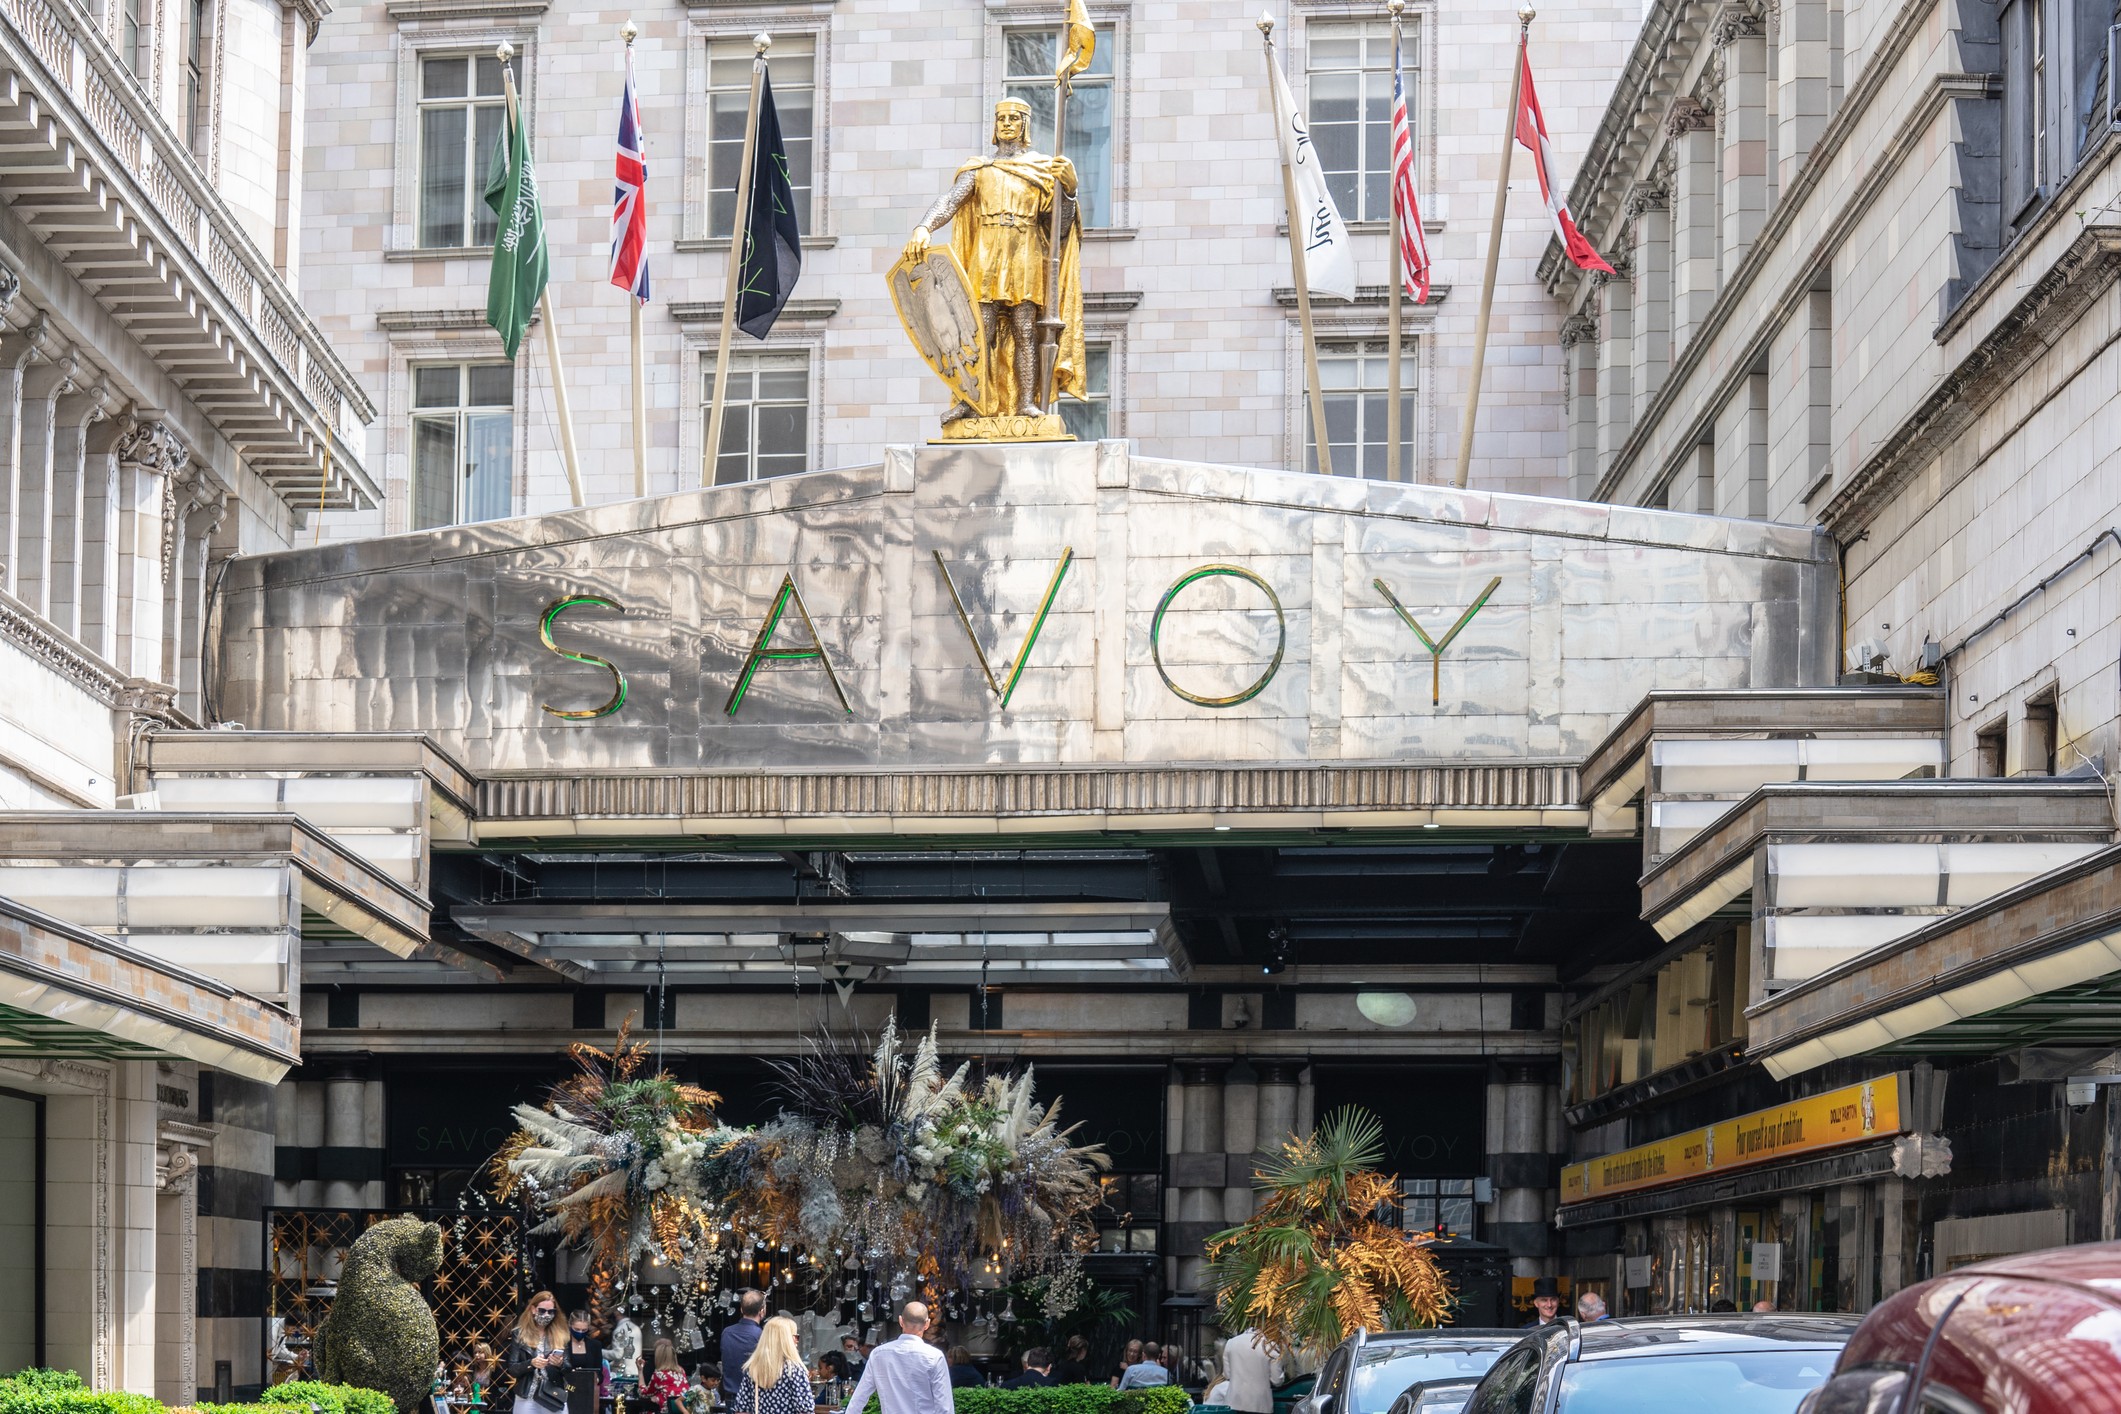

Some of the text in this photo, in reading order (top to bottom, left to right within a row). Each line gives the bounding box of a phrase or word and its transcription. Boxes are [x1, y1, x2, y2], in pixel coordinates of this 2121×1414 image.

[963, 416, 1047, 438] SAVOY
[539, 546, 1502, 721] SAVOY
[1830, 1103, 1857, 1124] DOLLY PARTON
[415, 1126, 507, 1152] SAVO
